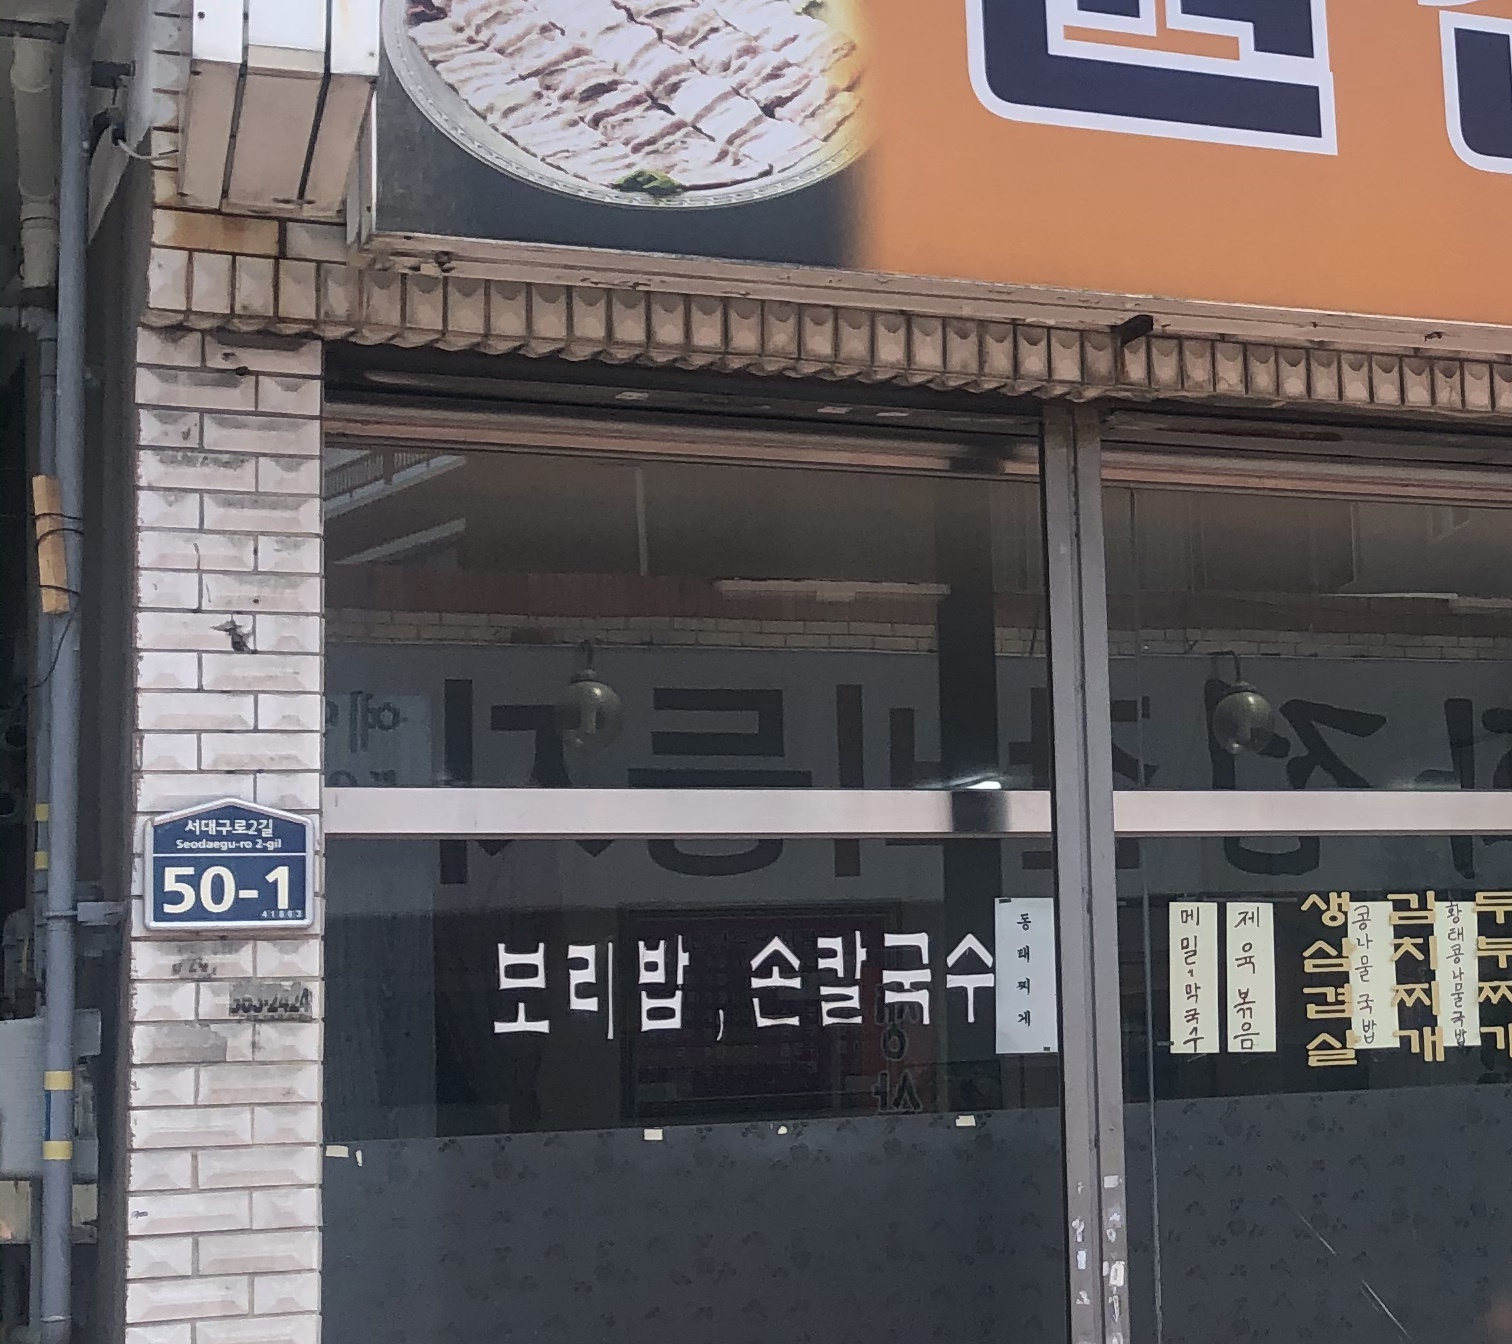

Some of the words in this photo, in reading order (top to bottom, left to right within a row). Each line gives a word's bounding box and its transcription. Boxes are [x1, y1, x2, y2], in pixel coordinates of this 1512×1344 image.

[175, 838, 253, 850] Seodaegu-ro
[255, 838, 282, 851] 2-gil
[184, 818, 274, 837] 서대구로2길
[162, 865, 290, 914] 50-1
[750, 930, 995, 1028] 손칼국수
[1300, 891, 1361, 1067] 생삼겹살
[1387, 891, 1445, 1062] 김치찌개
